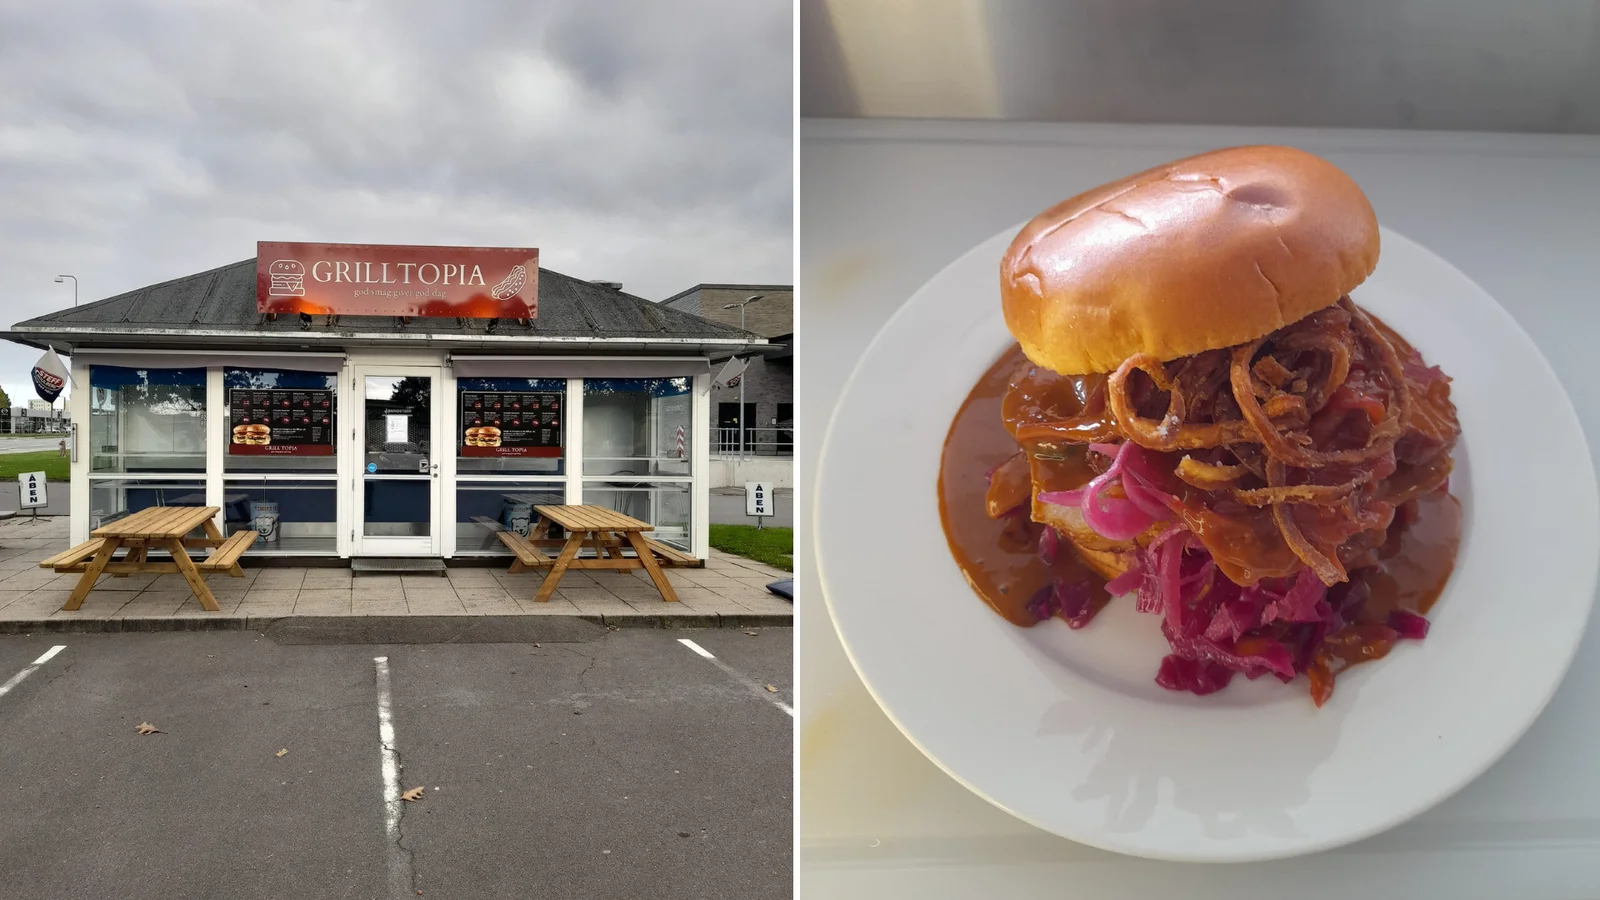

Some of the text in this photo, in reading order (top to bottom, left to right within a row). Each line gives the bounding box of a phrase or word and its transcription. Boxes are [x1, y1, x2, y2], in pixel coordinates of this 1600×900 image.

[311, 260, 486, 287] GRILLTOPIA
[354, 287, 447, 300] god smag giver god dag
[39, 370, 60, 384] STEFF
[28, 473, 38, 503] ÅBEN
[755, 484, 764, 513] ÅBEN
